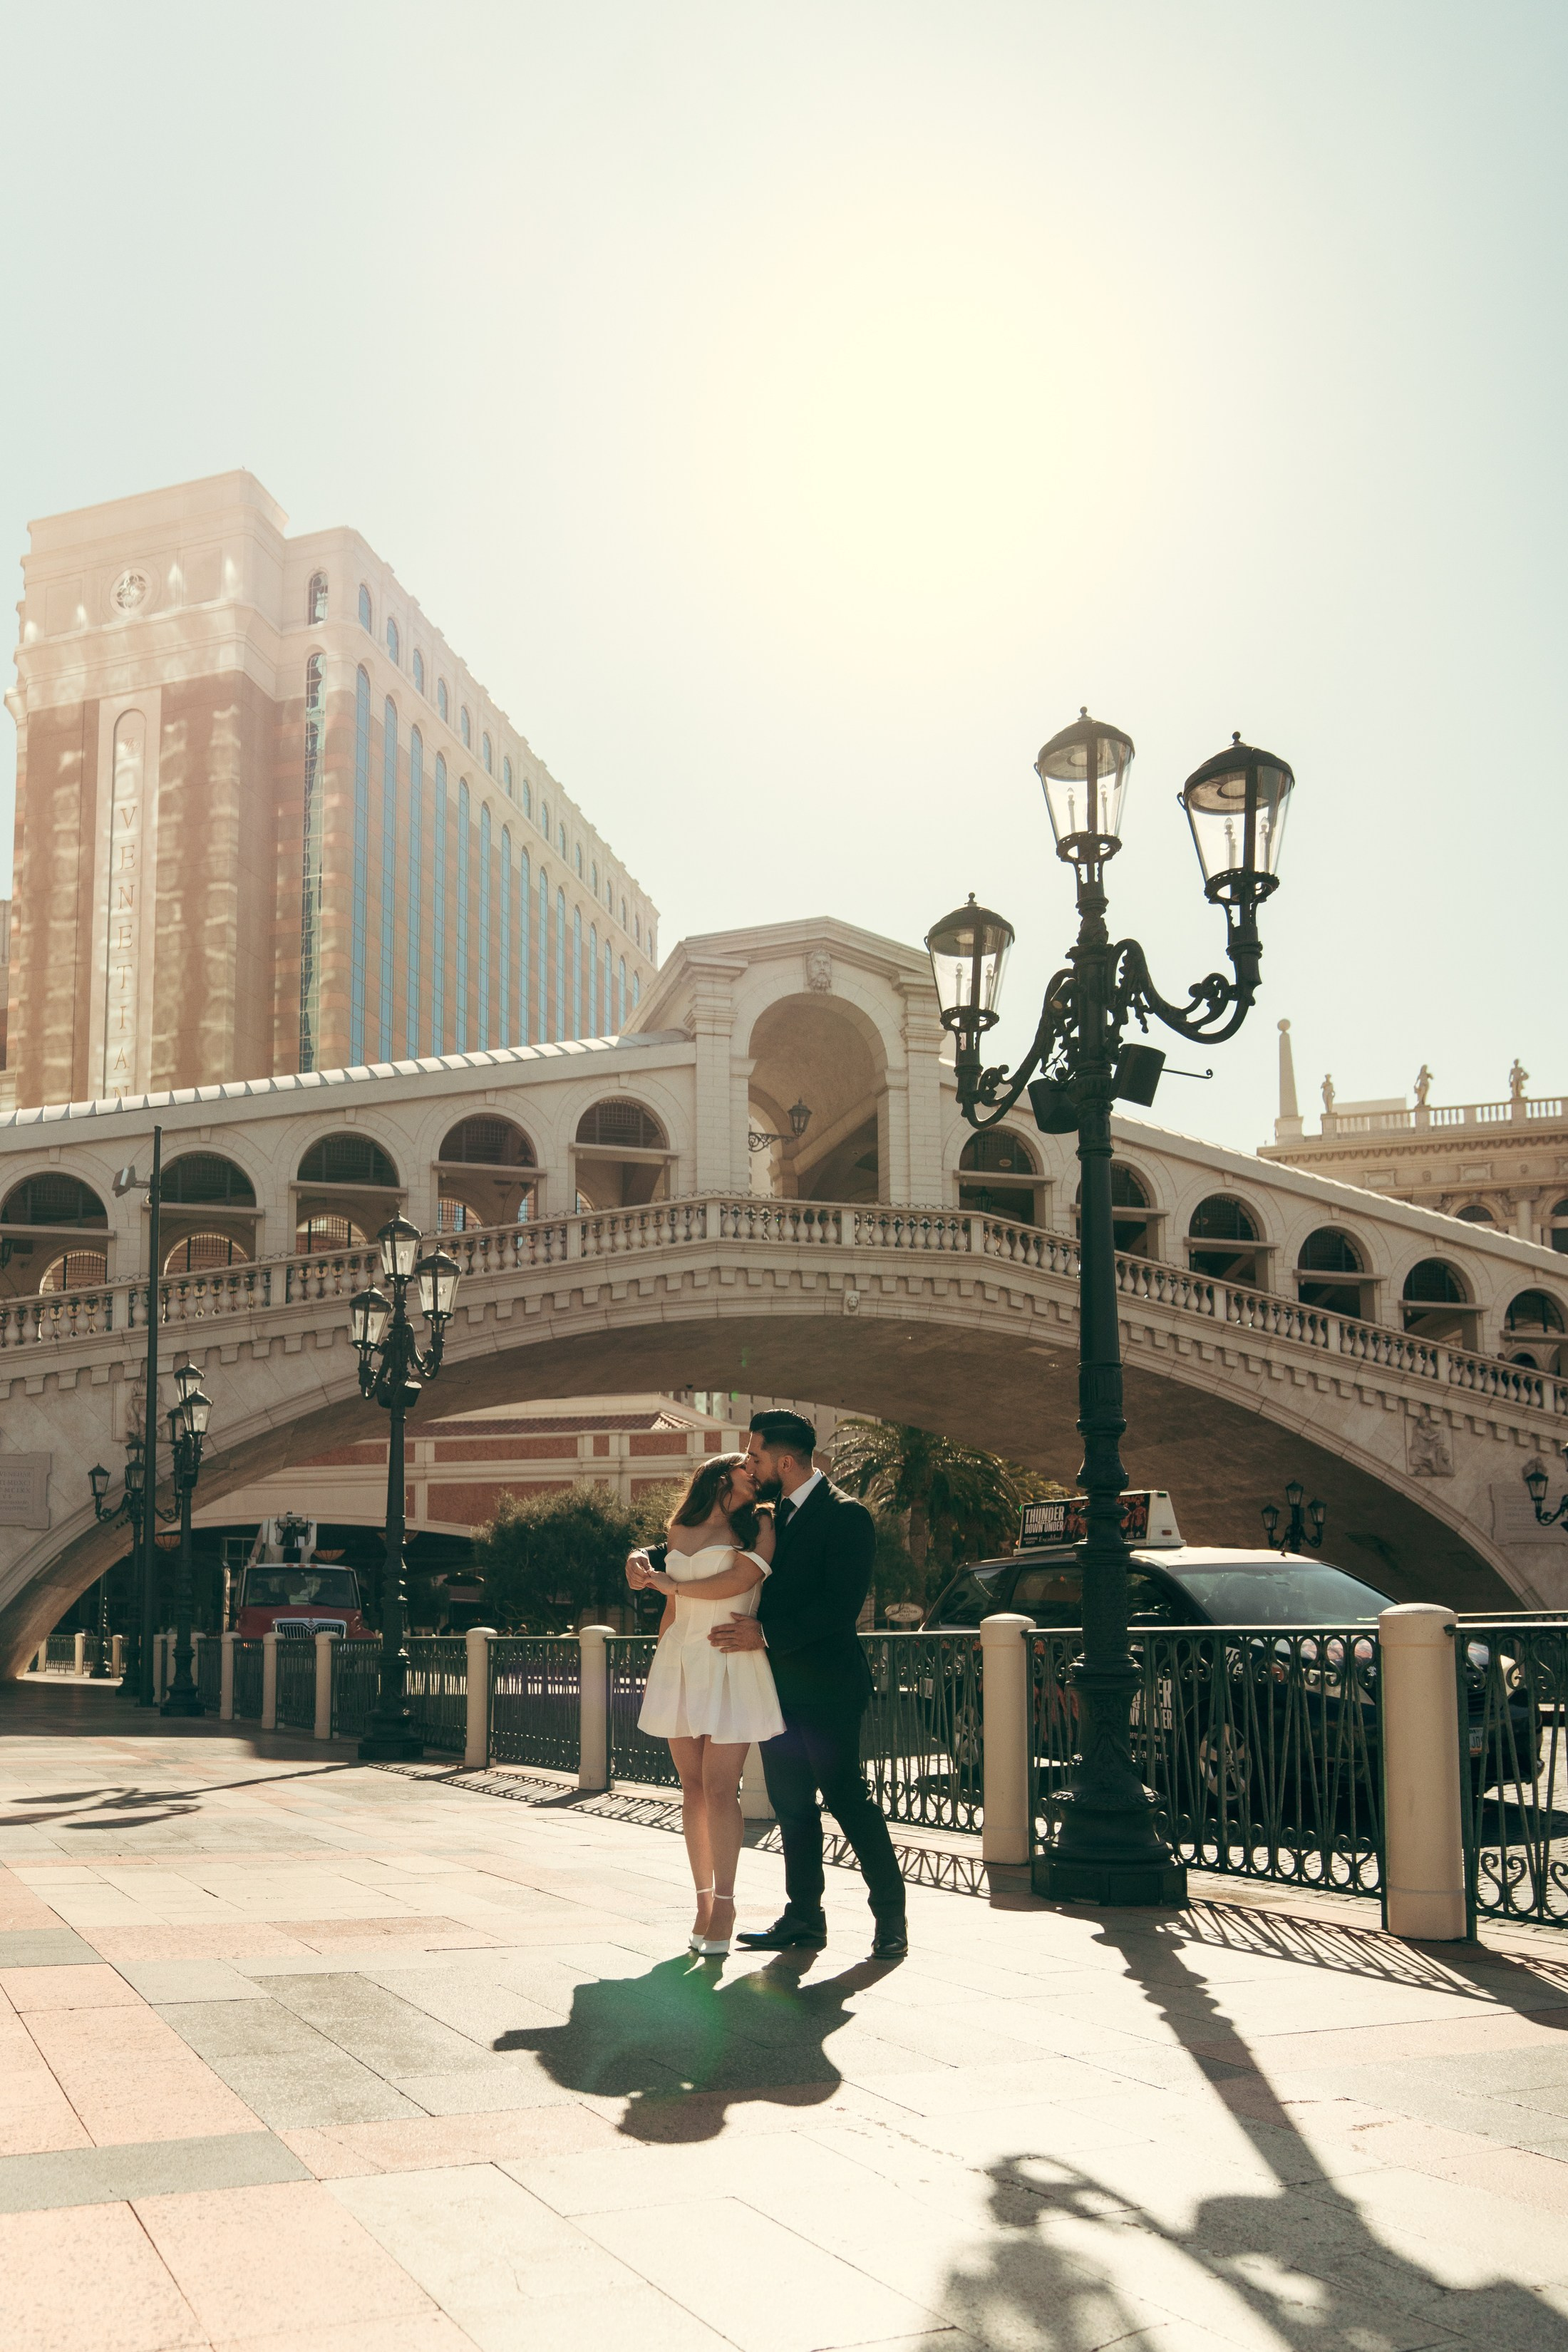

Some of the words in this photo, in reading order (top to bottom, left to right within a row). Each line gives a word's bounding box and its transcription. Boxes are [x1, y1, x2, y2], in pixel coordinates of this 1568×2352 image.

[1025, 1506, 1065, 1523] THUNDER
[1024, 1523, 1043, 1534] DOWN
[1044, 1521, 1063, 1532] UNDER
